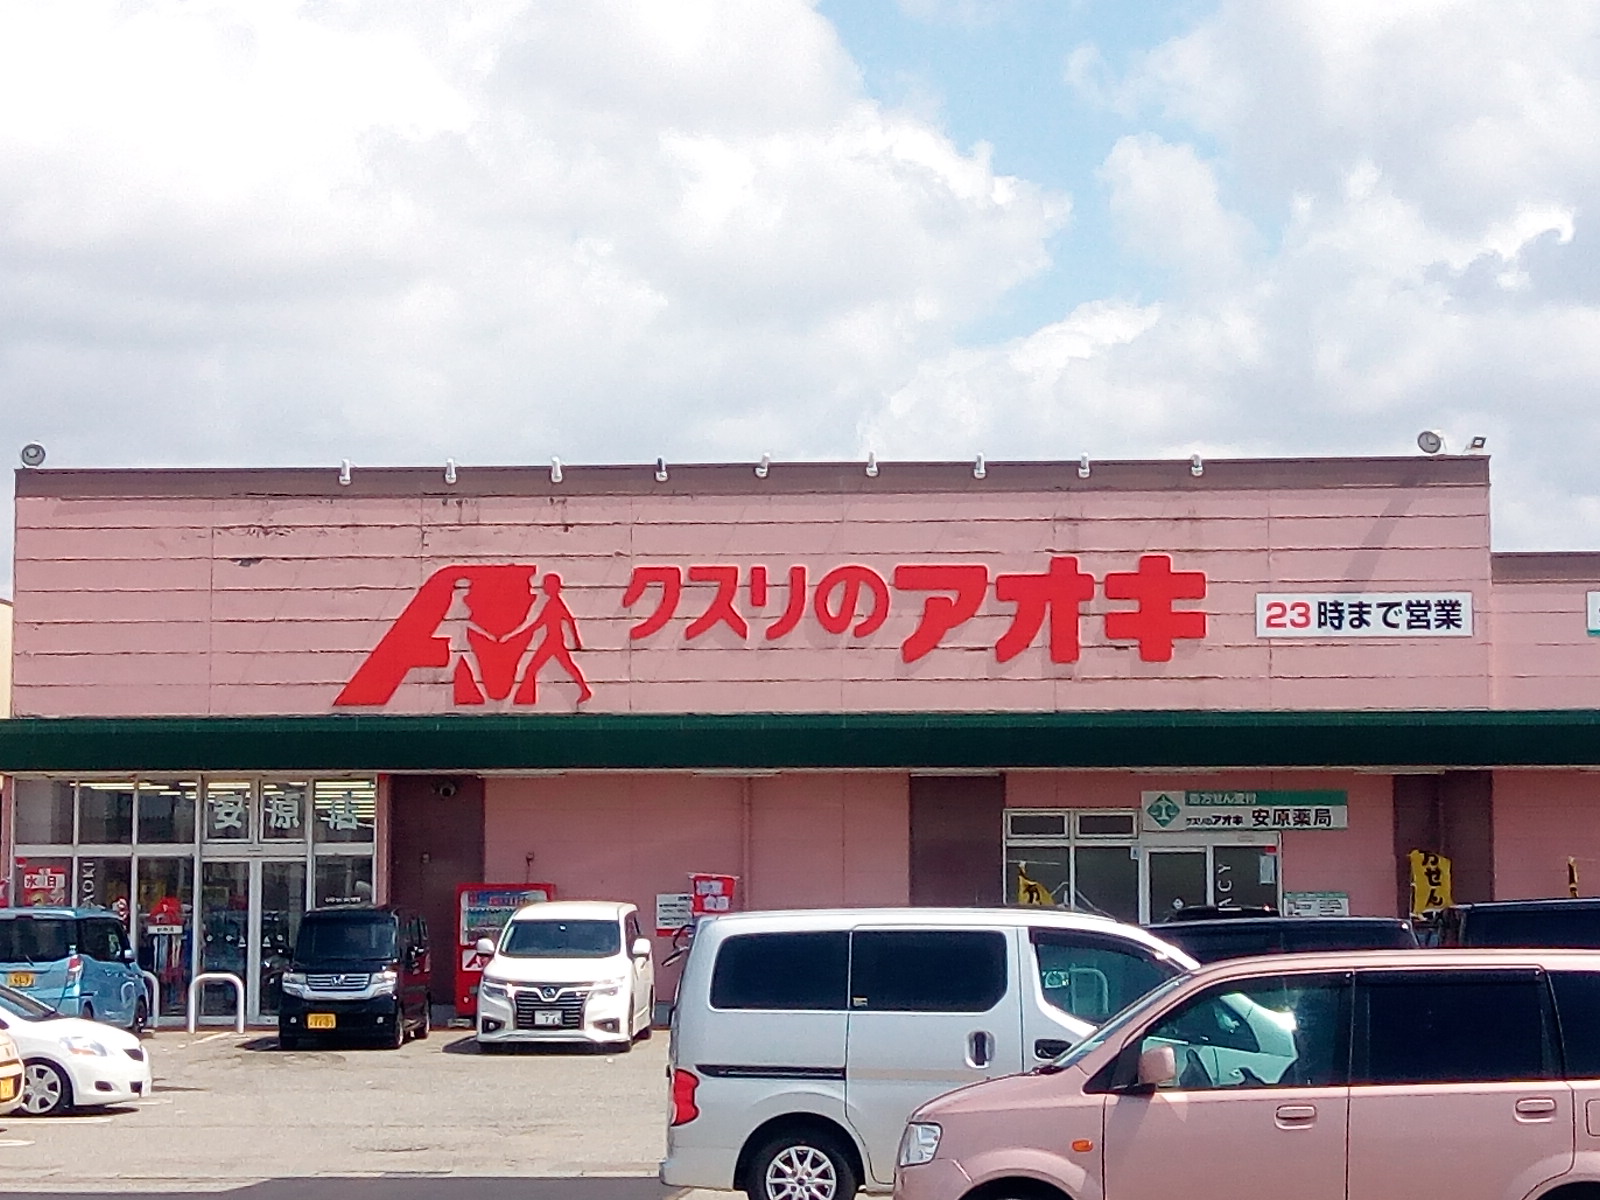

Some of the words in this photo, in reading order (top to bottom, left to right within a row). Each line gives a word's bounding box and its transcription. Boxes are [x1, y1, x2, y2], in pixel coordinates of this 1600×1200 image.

[621, 552, 1206, 664] クスリのアオキ
[1265, 599, 1463, 630] 23時まで営業
[1251, 808, 1332, 827] 安原薬局
